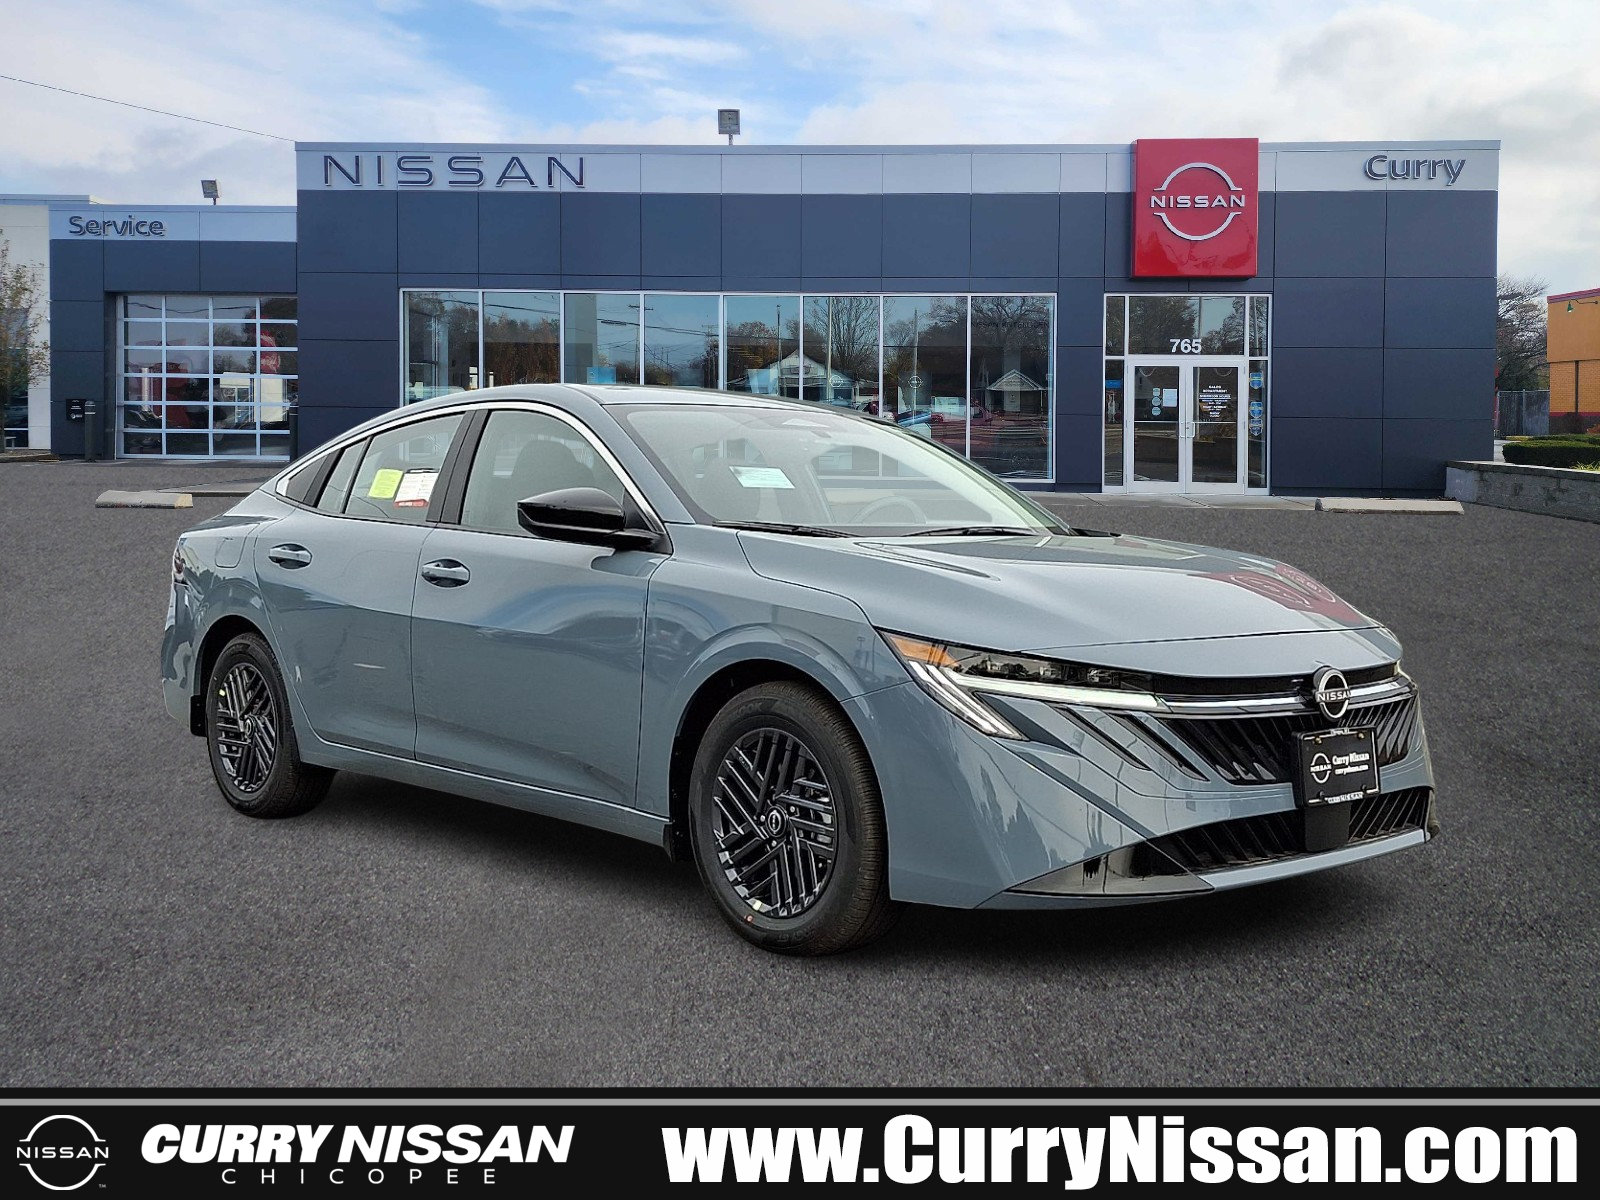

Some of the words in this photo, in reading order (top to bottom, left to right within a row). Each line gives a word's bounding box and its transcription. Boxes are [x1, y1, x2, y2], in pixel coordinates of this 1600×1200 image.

[323, 155, 584, 188] NISSAN
[1364, 154, 1466, 187] Curry
[1150, 194, 1246, 208] NISSAN
[69, 214, 165, 237] Service
[1169, 338, 1202, 354] 765
[1332, 755, 1349, 766] Curry
